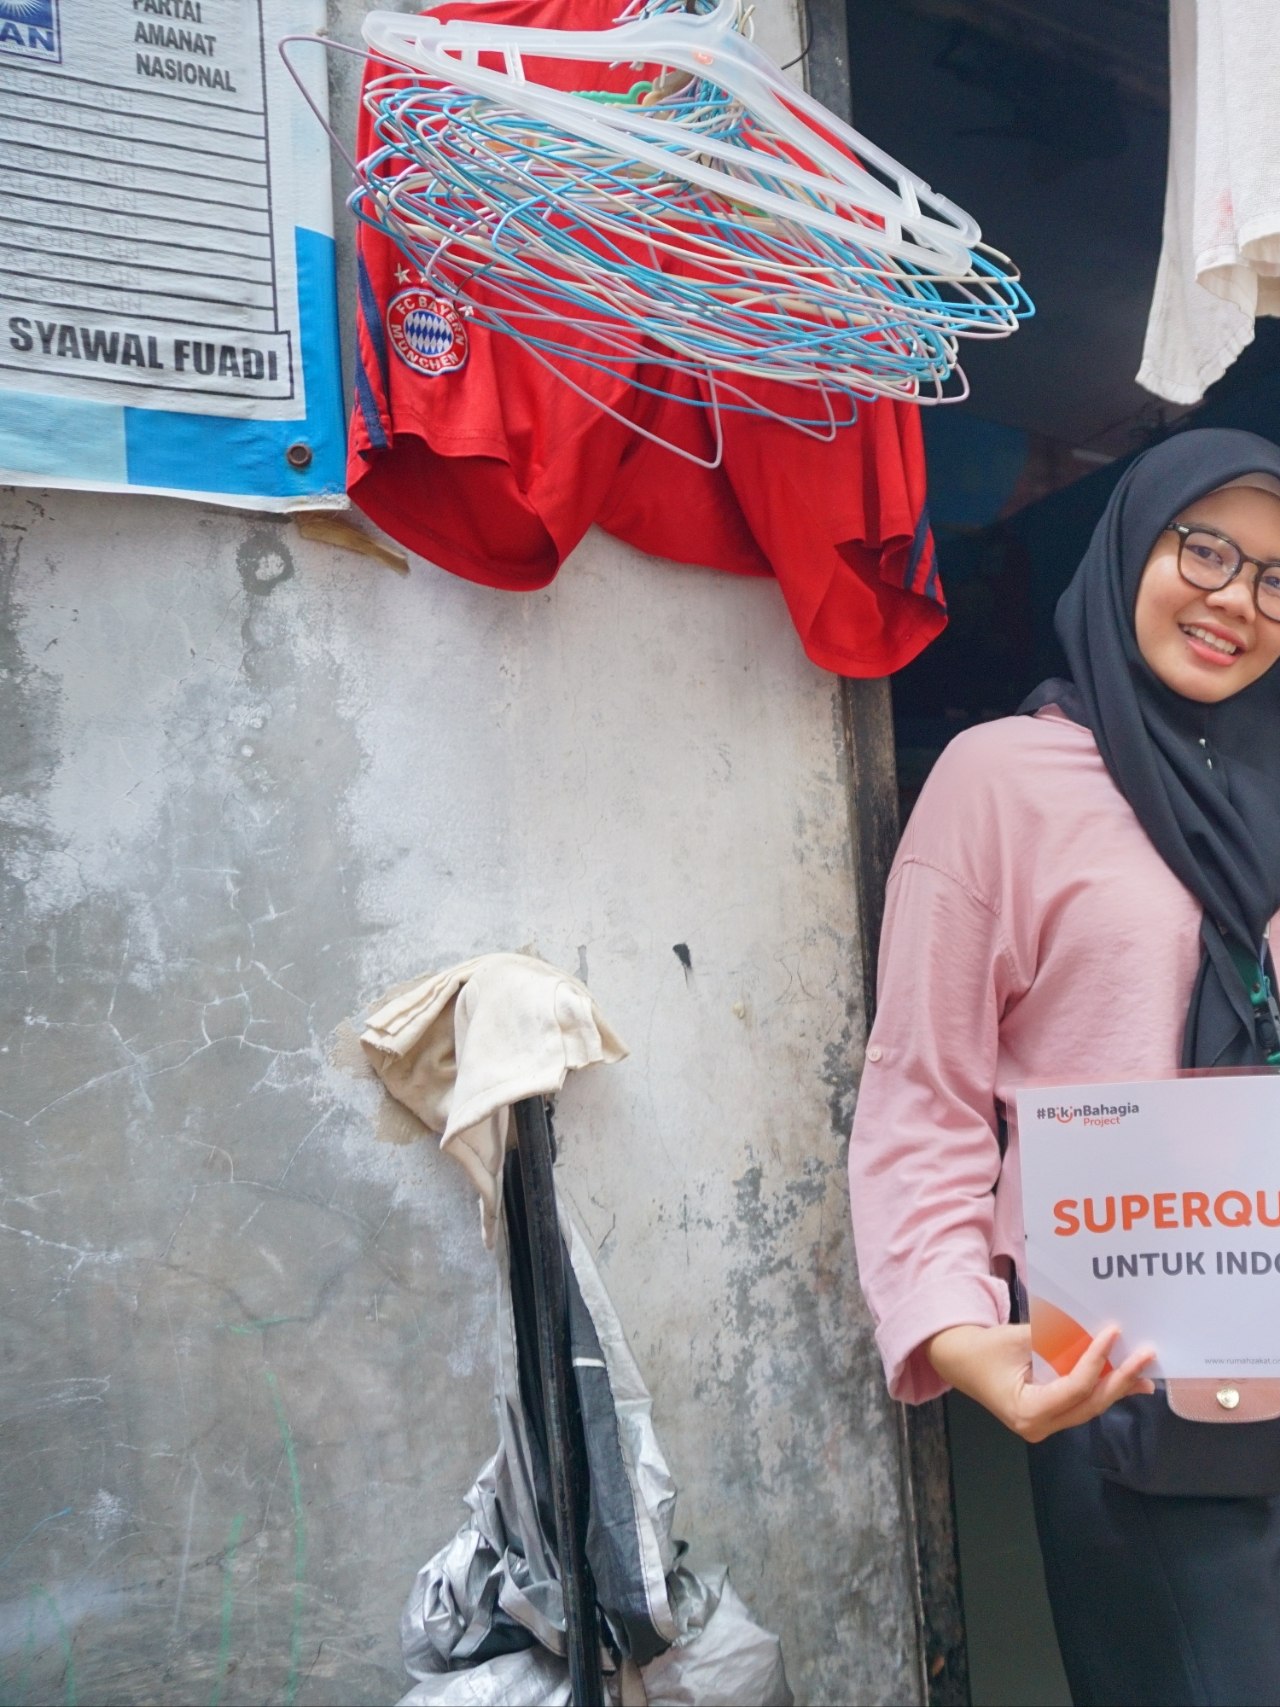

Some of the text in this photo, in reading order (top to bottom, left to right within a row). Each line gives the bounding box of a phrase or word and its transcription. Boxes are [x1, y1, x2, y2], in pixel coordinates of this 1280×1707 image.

[134, 21, 217, 57] AMANAT
[136, 53, 237, 92] NASIONAL
[395, 296, 465, 346] FC BAYERN
[8, 317, 279, 381] SYAWAL FUADI
[1083, 1116, 1121, 1127] Project
[1092, 1251, 1206, 1280] UNTUK
